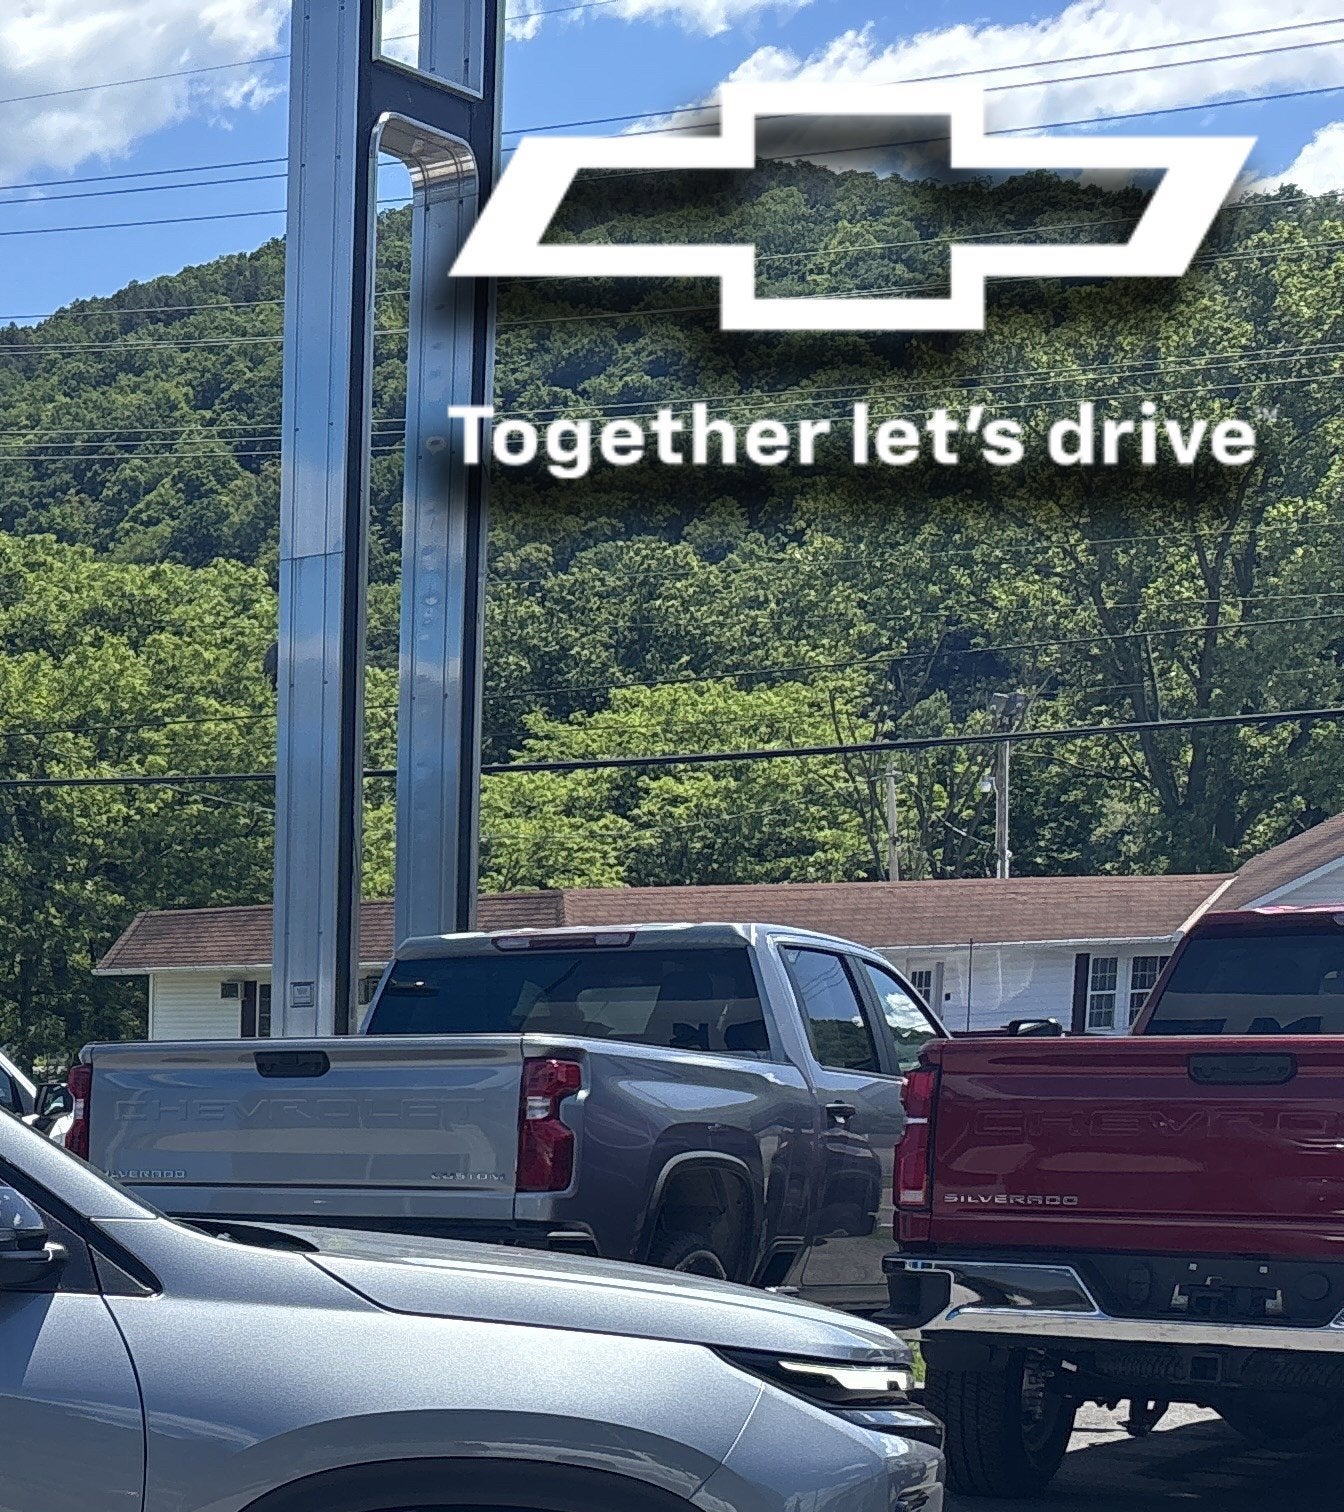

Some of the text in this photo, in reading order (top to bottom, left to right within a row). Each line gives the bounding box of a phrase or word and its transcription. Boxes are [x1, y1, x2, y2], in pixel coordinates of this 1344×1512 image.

[113, 1098, 485, 1121] CHEVROLET
[106, 1169, 187, 1179] ILVERADO
[943, 1193, 1079, 1206] SILVERADO
